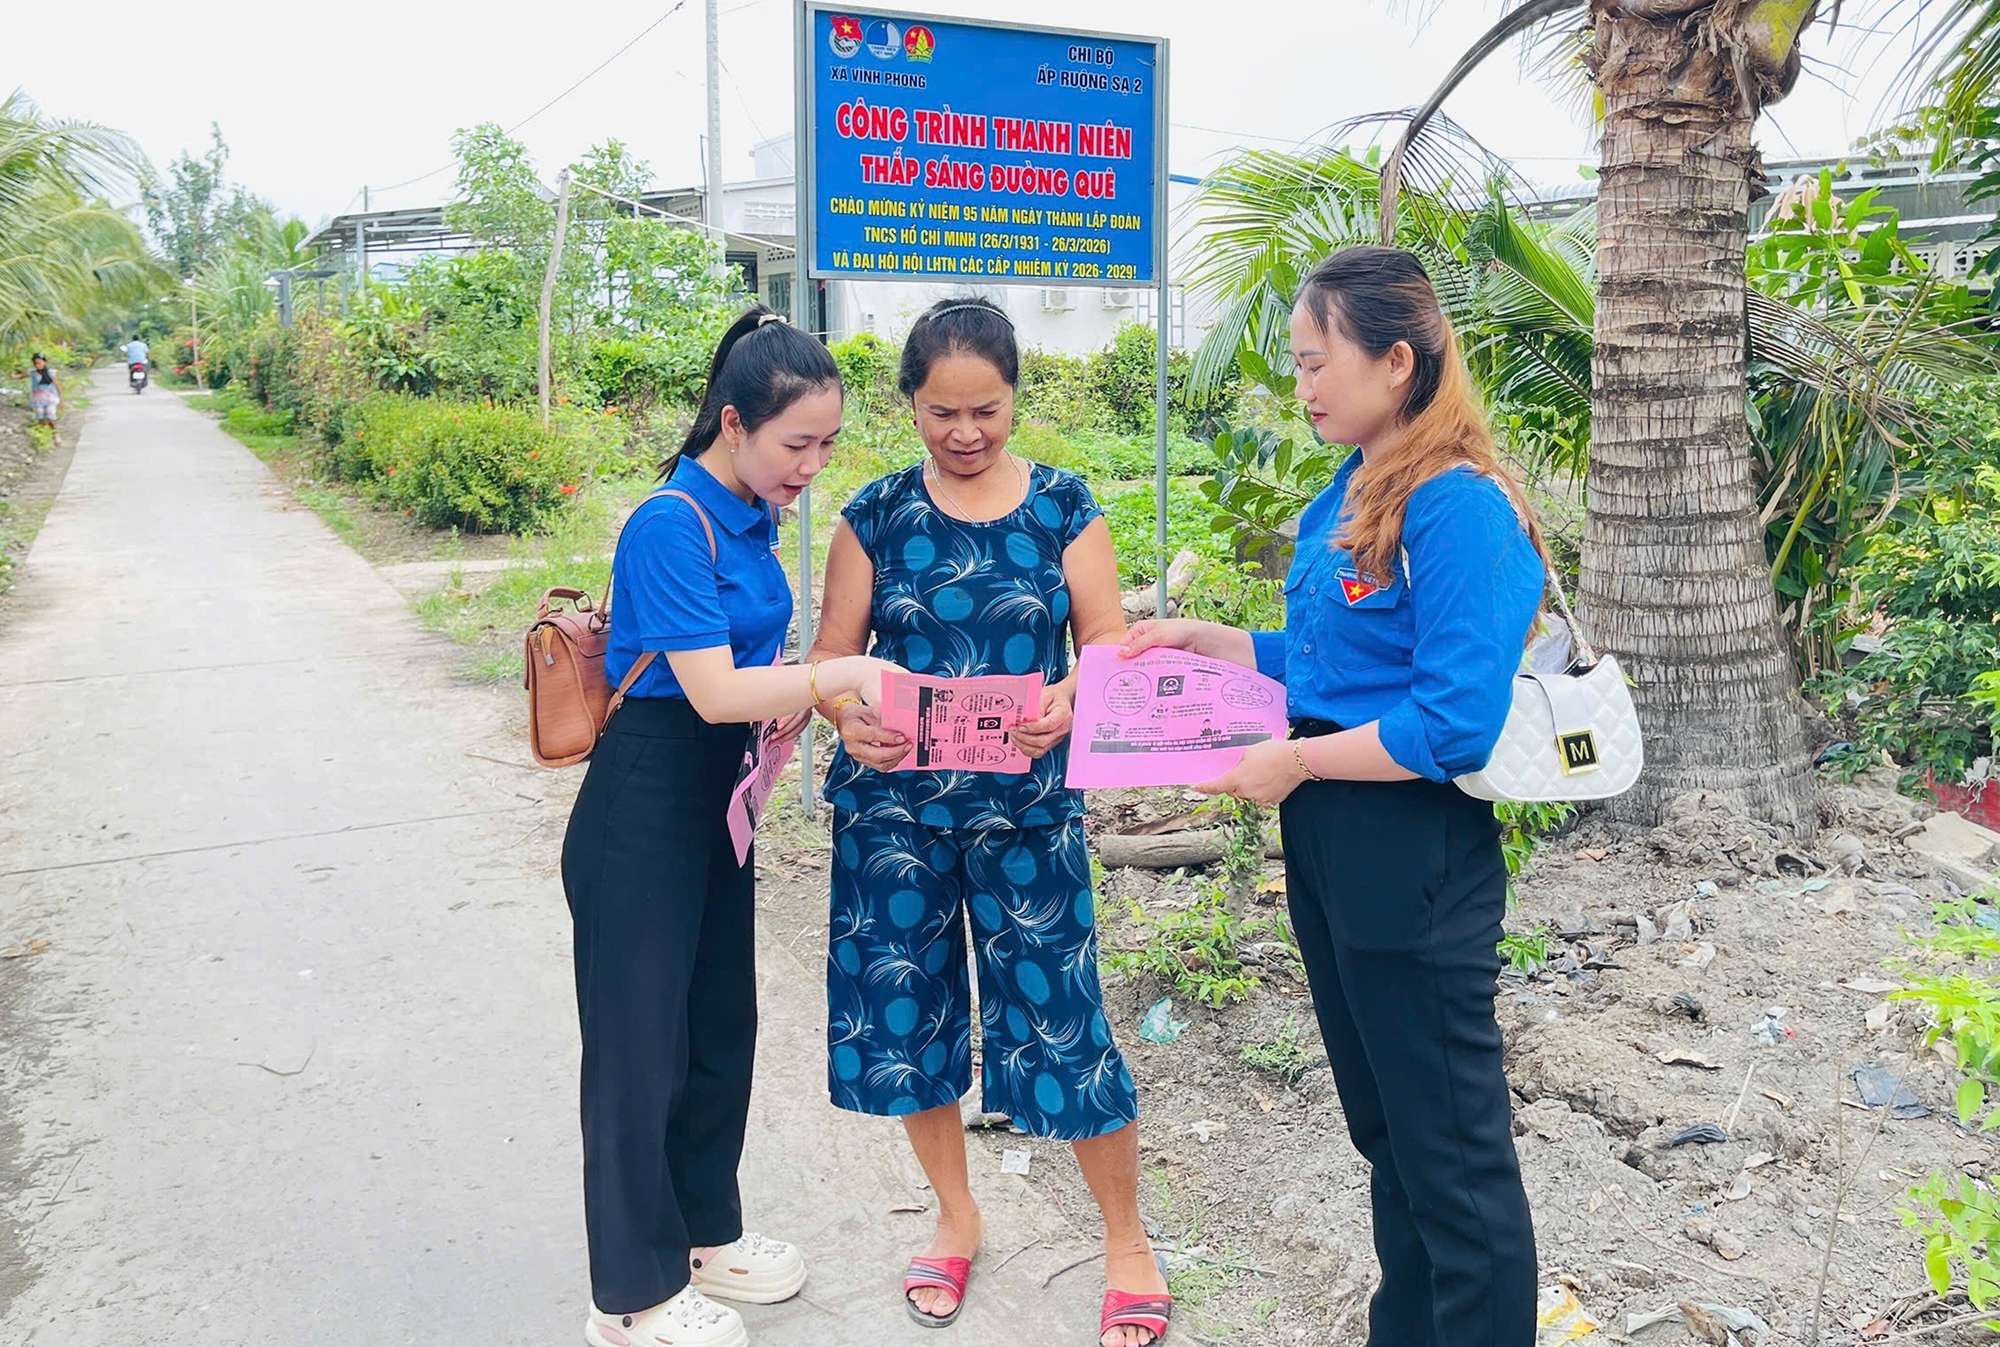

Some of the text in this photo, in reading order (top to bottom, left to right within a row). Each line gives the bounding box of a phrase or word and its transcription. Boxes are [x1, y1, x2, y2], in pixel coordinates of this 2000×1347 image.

[1068, 45, 1114, 68] CHI BỘ
[831, 65, 848, 81] XÃ
[884, 72, 926, 89] PHONG
[1037, 63, 1142, 96] ẤP RUỘNG SẠ 2
[836, 97, 1132, 159] CÔNG TRÌNH THANH NIÊN
[860, 147, 1115, 200] THẮP SÁNG ĐƯỜNG QUÊ
[830, 196, 1141, 231] CHÀO MỪNG KỶ NIỆM 95 NĂM NGÀY THÀNH LẬP ĐOÀN
[864, 226, 897, 243] TNCS
[921, 227, 940, 245] CHÍ
[944, 230, 976, 247] MINH
[980, 233, 1039, 250] (26/3/1931
[1052, 236, 1111, 255] 26/3/2026)
[832, 249, 849, 268] VÀ
[853, 252, 874, 273] ĐẠI
[878, 251, 899, 273] HỘI
[902, 252, 923, 275] HỘI
[926, 256, 957, 272] LHTN
[960, 255, 984, 273] CÁC
[987, 254, 1011, 275] CẤP
[1014, 258, 1051, 278] NHIỆM
[1054, 259, 1069, 277] KỲ
[1106, 264, 1137, 279] 2029!
[1569, 740, 1590, 762] M
